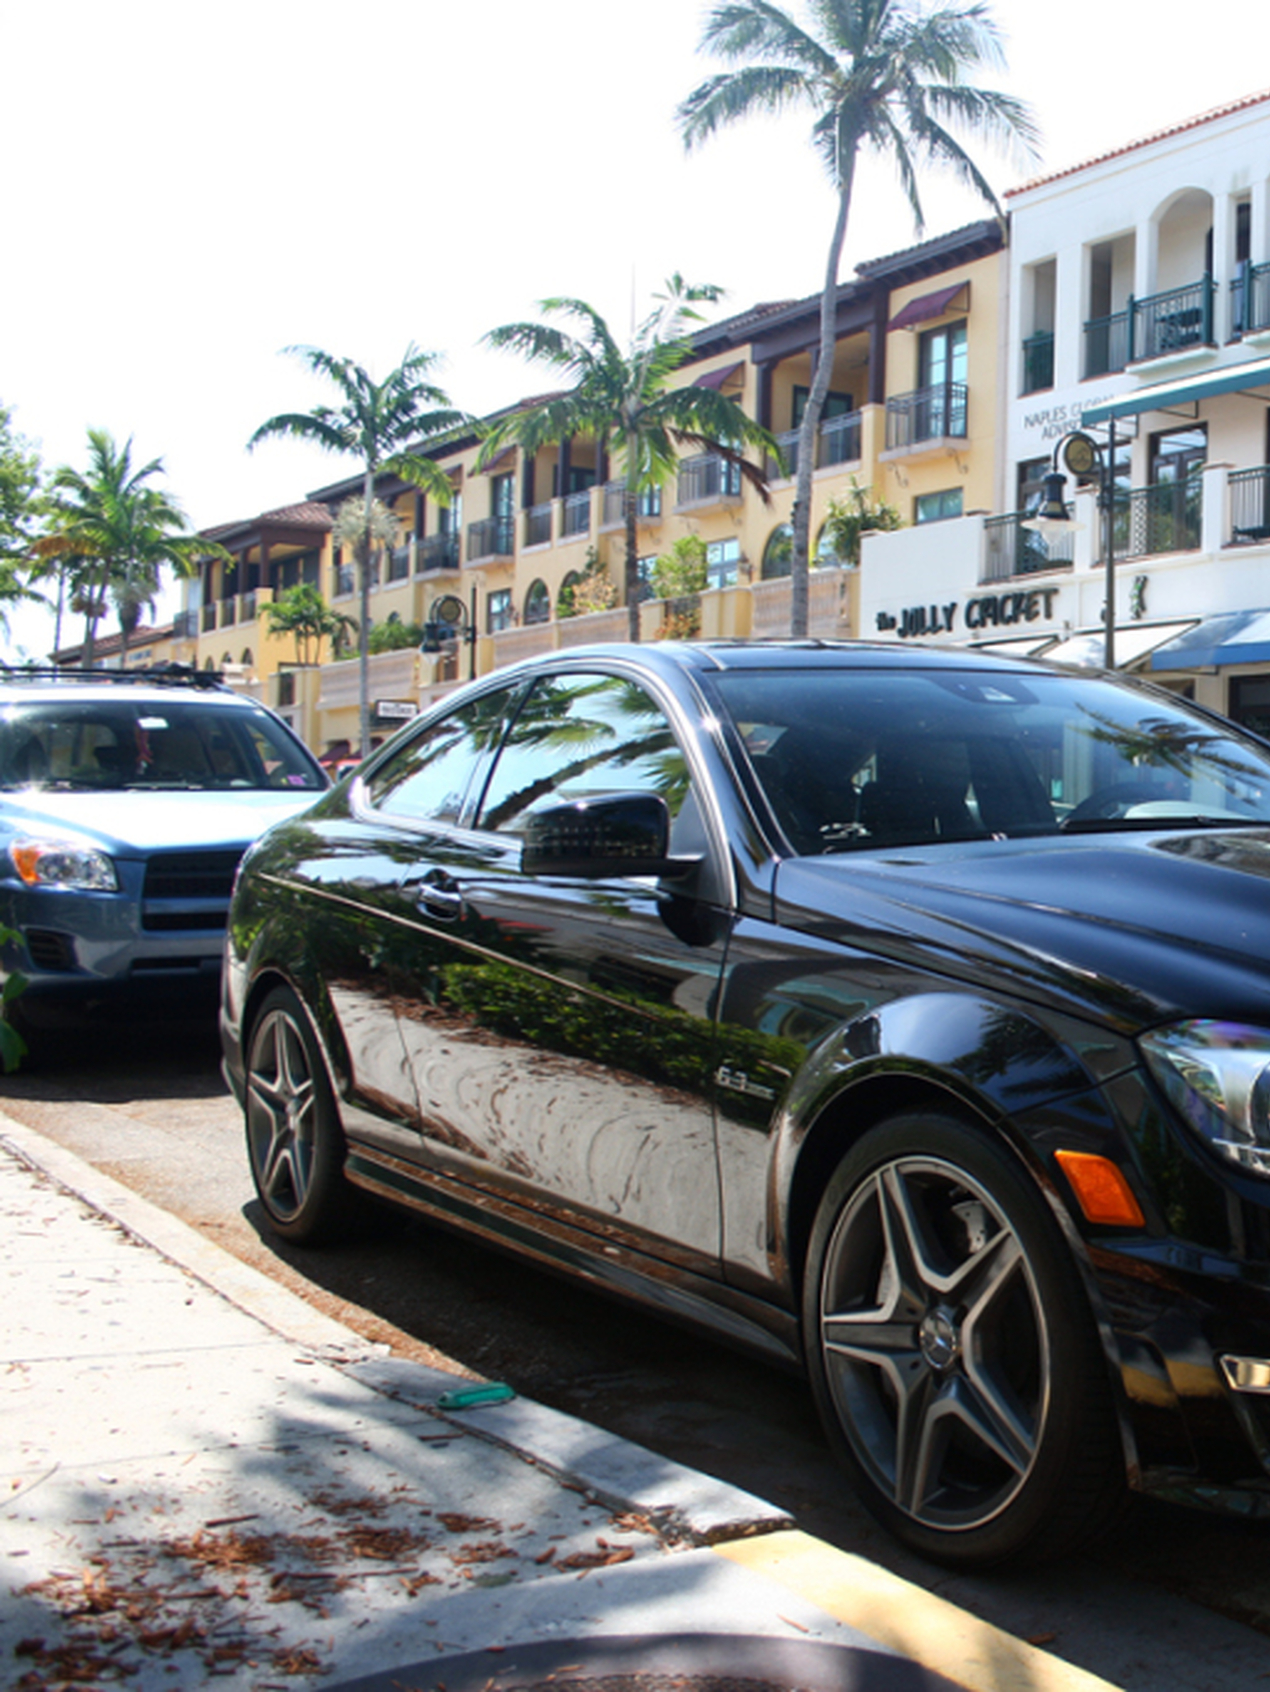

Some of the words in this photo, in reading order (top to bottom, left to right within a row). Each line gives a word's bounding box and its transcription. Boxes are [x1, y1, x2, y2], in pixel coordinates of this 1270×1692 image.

[1024, 405, 1068, 429] NAPLES
[876, 611, 897, 631] the
[898, 602, 957, 638] JOLLY
[965, 587, 1059, 629] CRICKET
